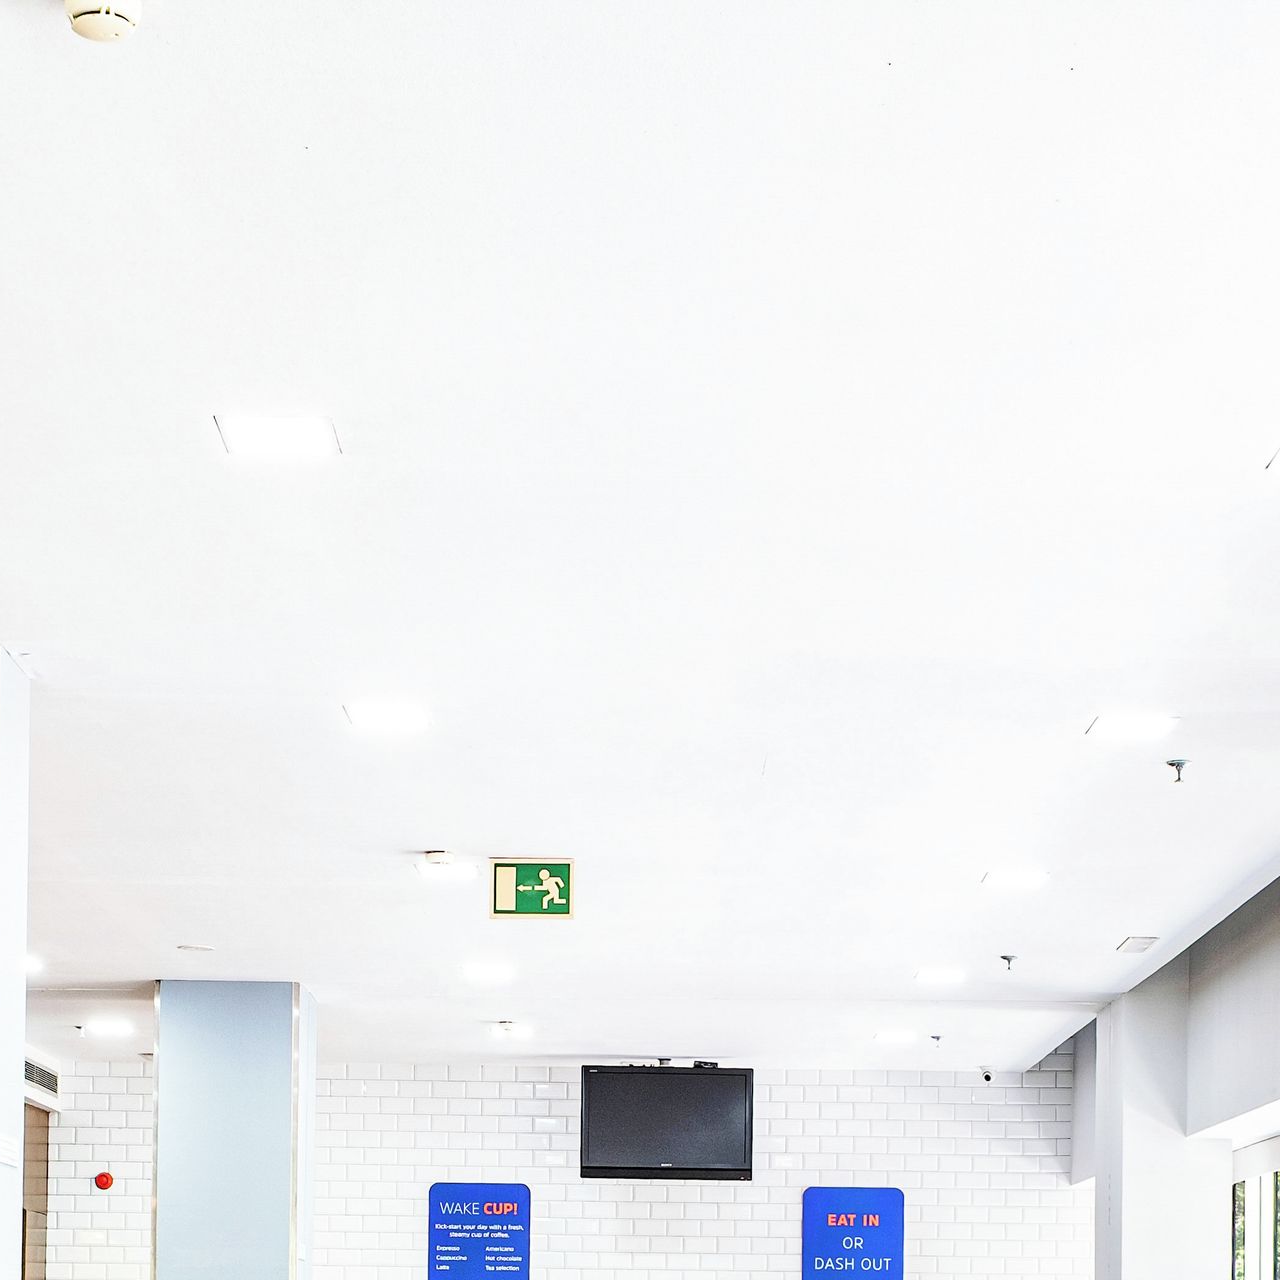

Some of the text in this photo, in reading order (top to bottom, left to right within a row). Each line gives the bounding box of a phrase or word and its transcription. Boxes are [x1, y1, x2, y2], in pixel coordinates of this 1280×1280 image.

[440, 1202, 518, 1216] WAKE CUP!
[827, 1214, 880, 1226] EAT IN
[842, 1237, 863, 1249] OR
[814, 1258, 891, 1270] DASH OUT
